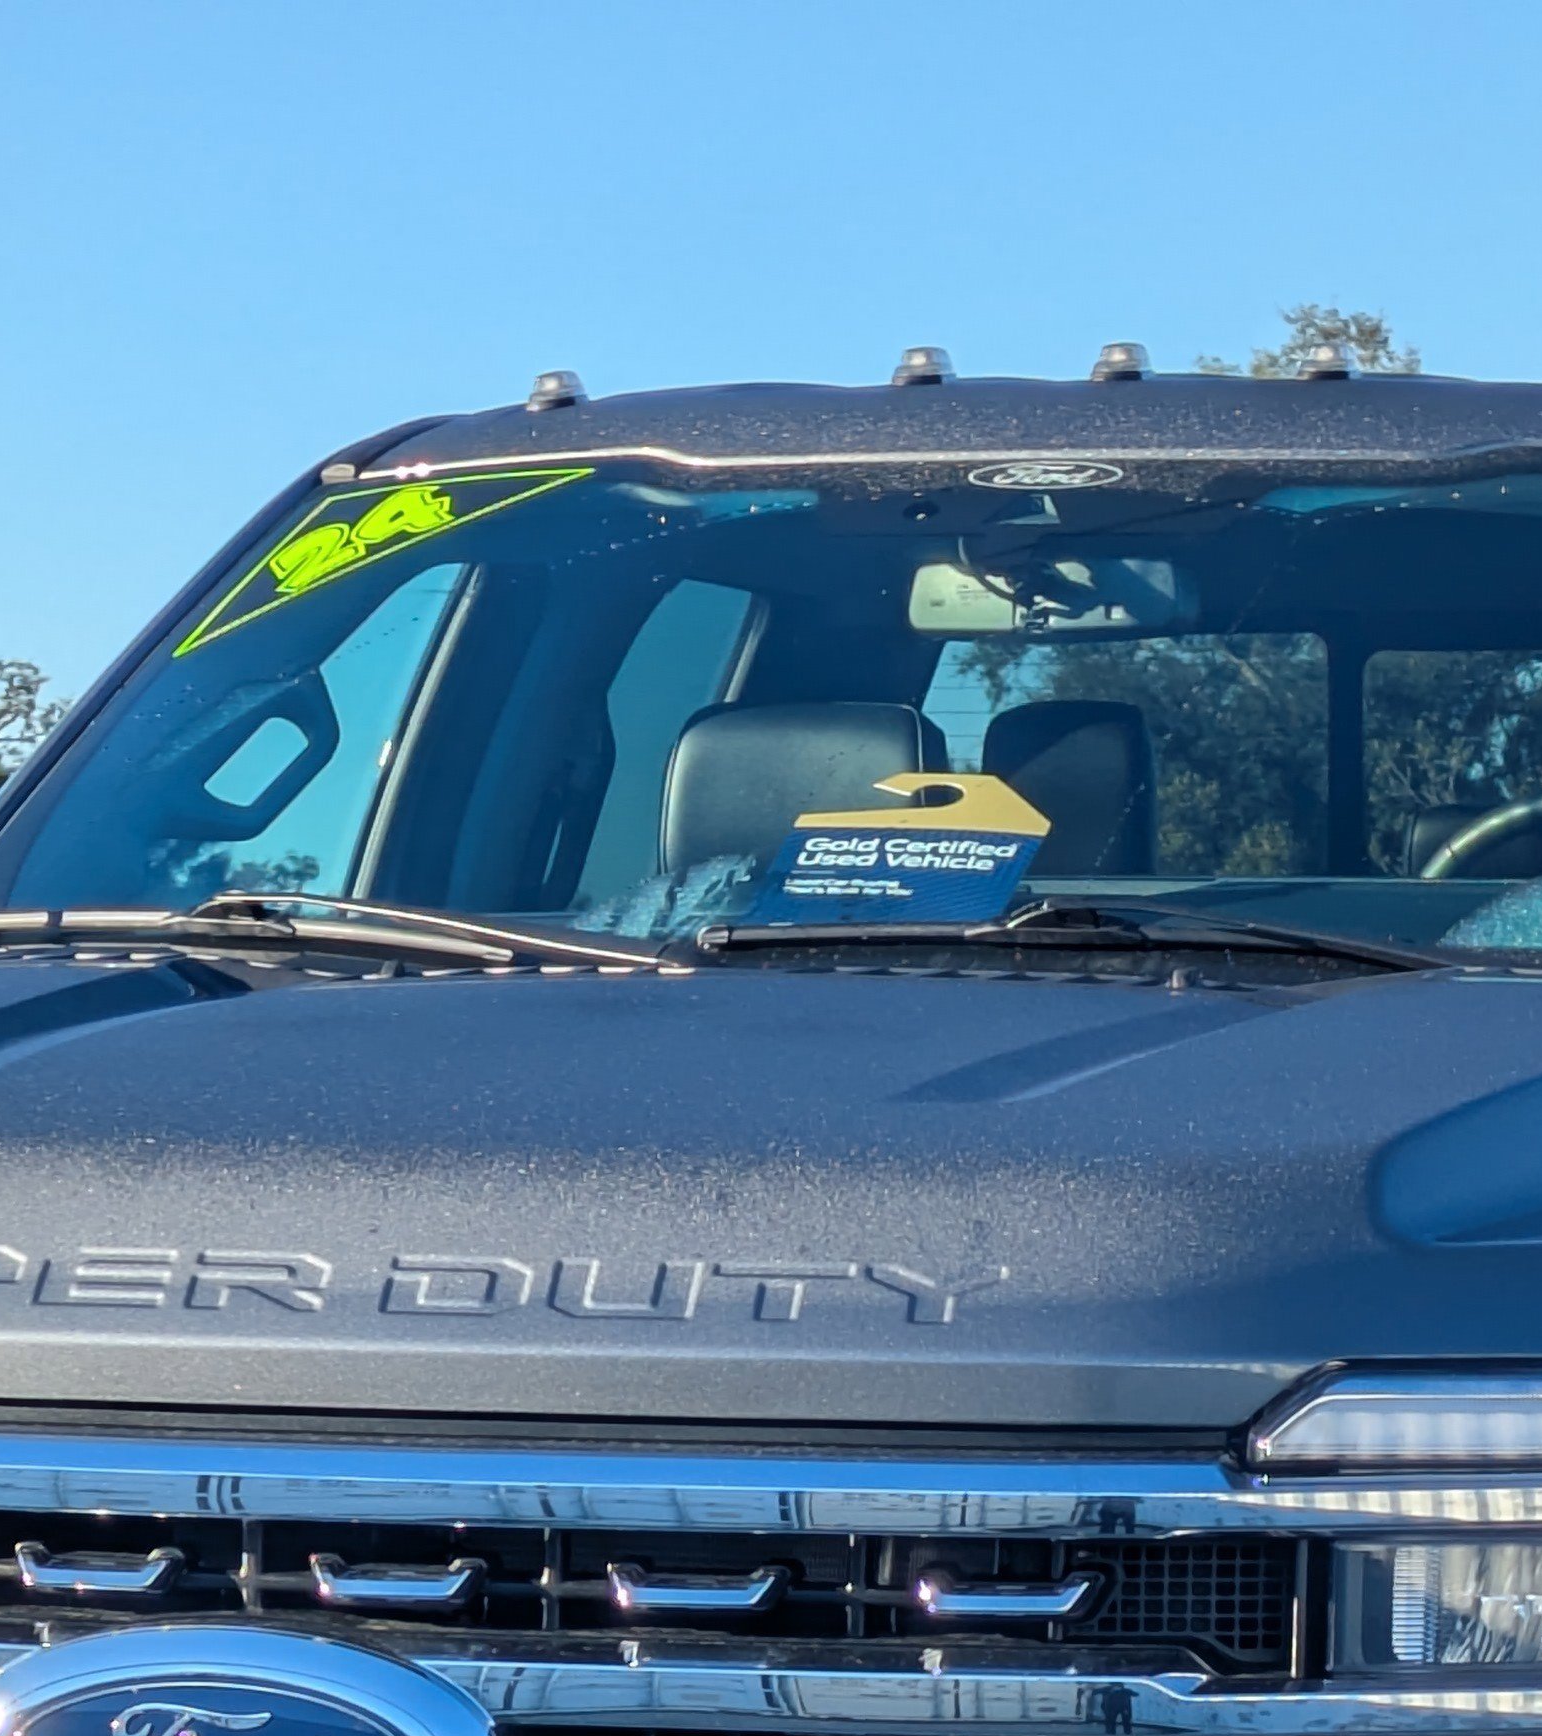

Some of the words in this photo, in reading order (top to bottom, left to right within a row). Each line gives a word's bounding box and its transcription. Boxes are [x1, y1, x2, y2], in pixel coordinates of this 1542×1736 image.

[992, 463, 1097, 484] Ford
[268, 485, 456, 593] 24
[804, 837, 881, 852] Gold
[884, 838, 1018, 858] Certified
[796, 852, 878, 867] Used
[885, 853, 995, 871] Vehicle
[378, 1255, 1010, 1325] DUTY
